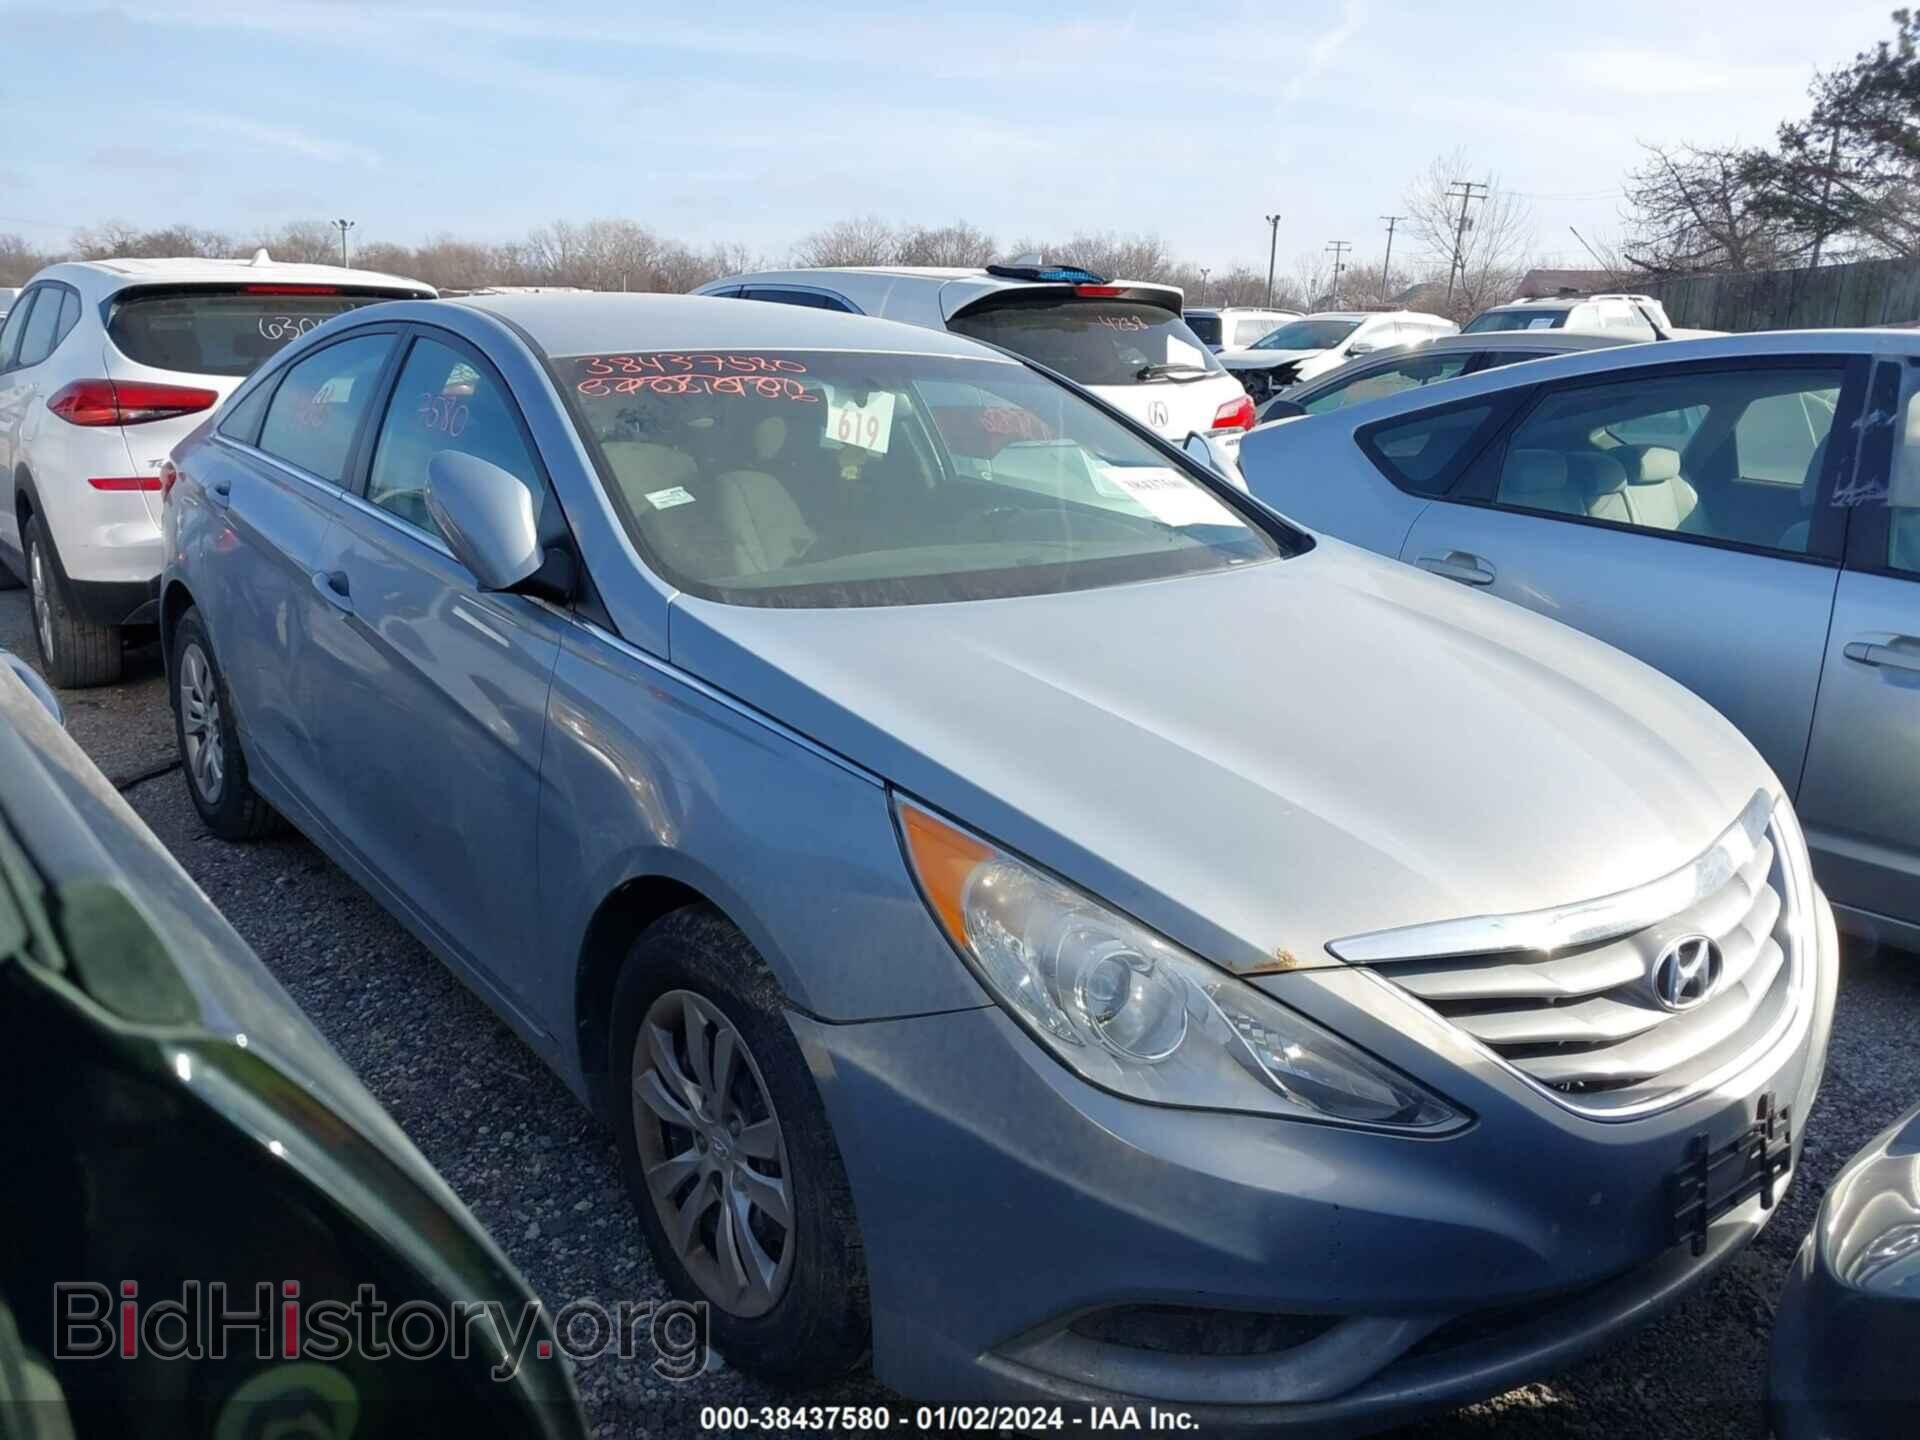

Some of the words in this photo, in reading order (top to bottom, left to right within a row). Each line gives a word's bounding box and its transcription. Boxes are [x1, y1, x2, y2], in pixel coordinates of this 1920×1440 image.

[258, 316, 323, 340] 630
[576, 354, 807, 374] 38437580
[838, 409, 880, 448] 619
